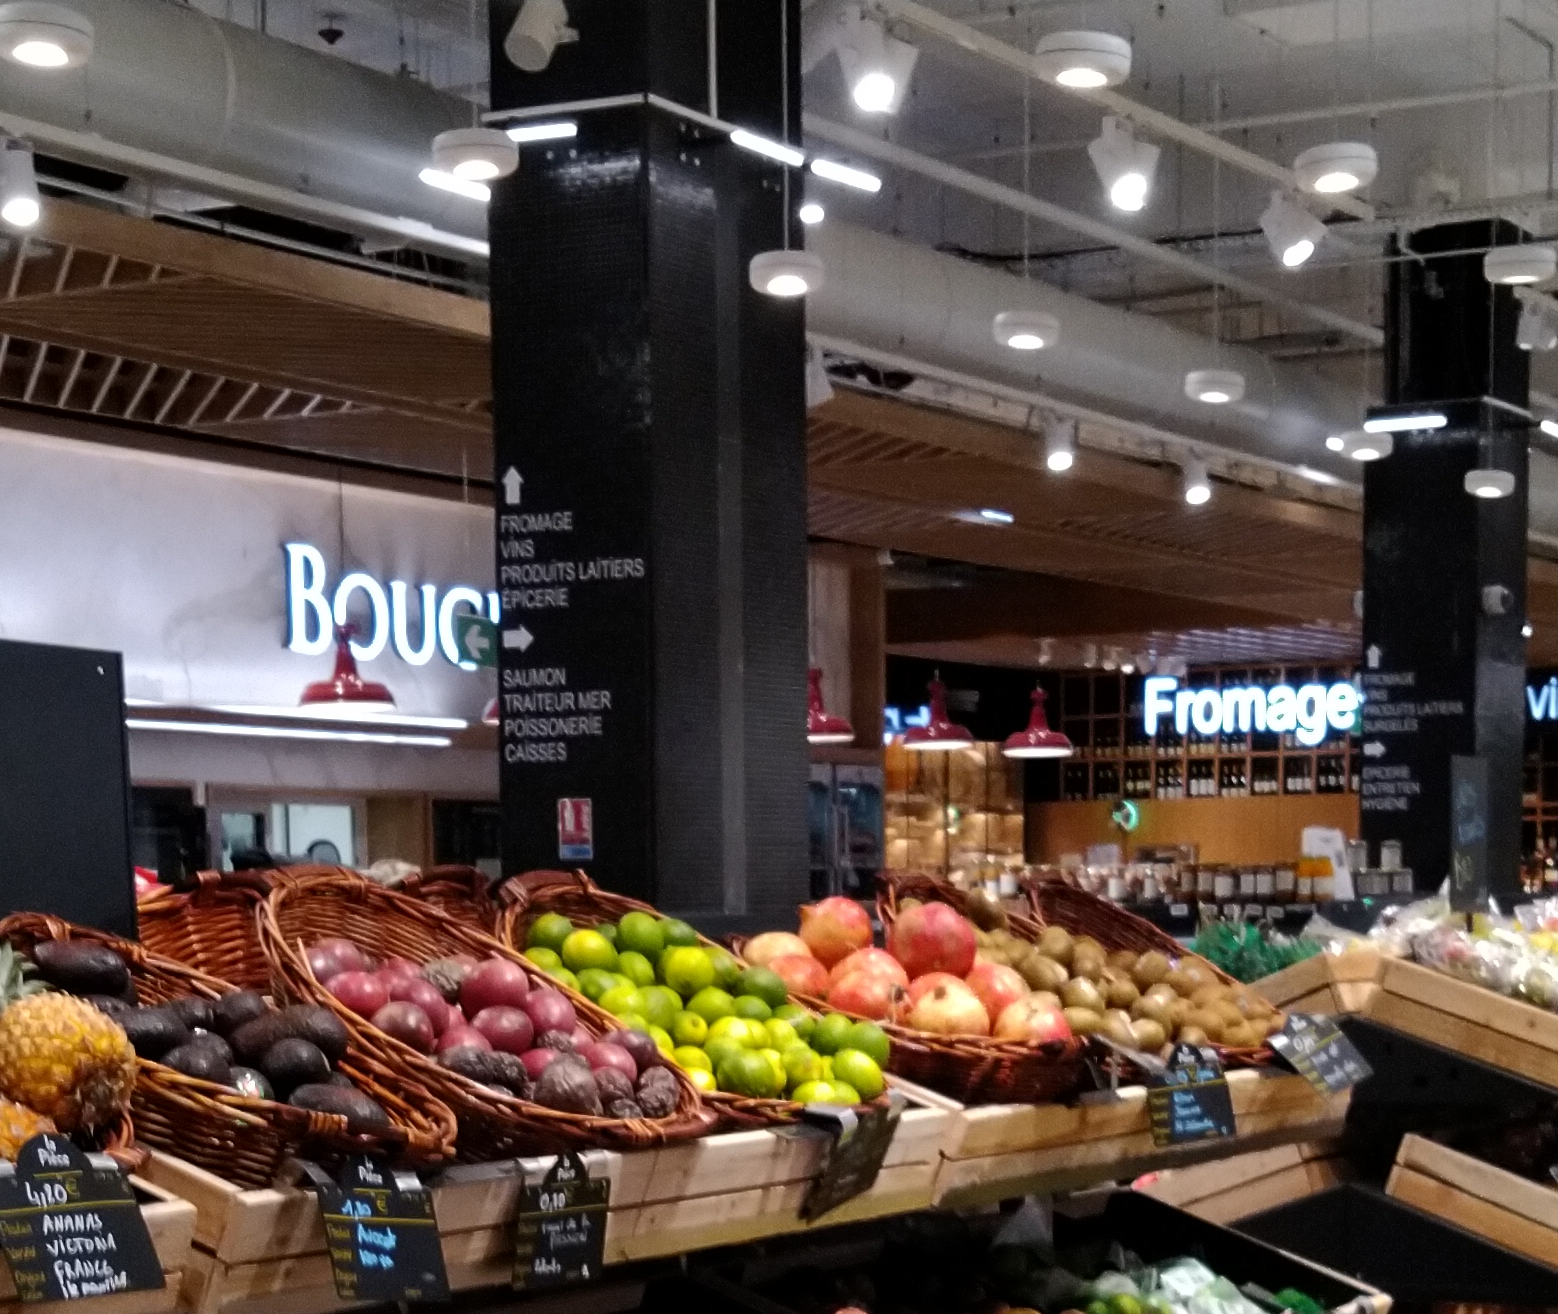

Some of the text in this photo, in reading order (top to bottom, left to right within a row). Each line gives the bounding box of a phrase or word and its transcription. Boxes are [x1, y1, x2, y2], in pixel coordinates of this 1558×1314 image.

[500, 511, 574, 534] FROMAGE
[501, 556, 644, 585] PRODUITS LAITIERS
[503, 667, 566, 688] SAUMON
[504, 690, 611, 712] TRAITEUR MER
[1144, 676, 1357, 746] Fromage
[504, 716, 603, 738] POISSONERIE
[505, 741, 567, 763] CAISSES
[43, 1212, 103, 1236] ANANAS
